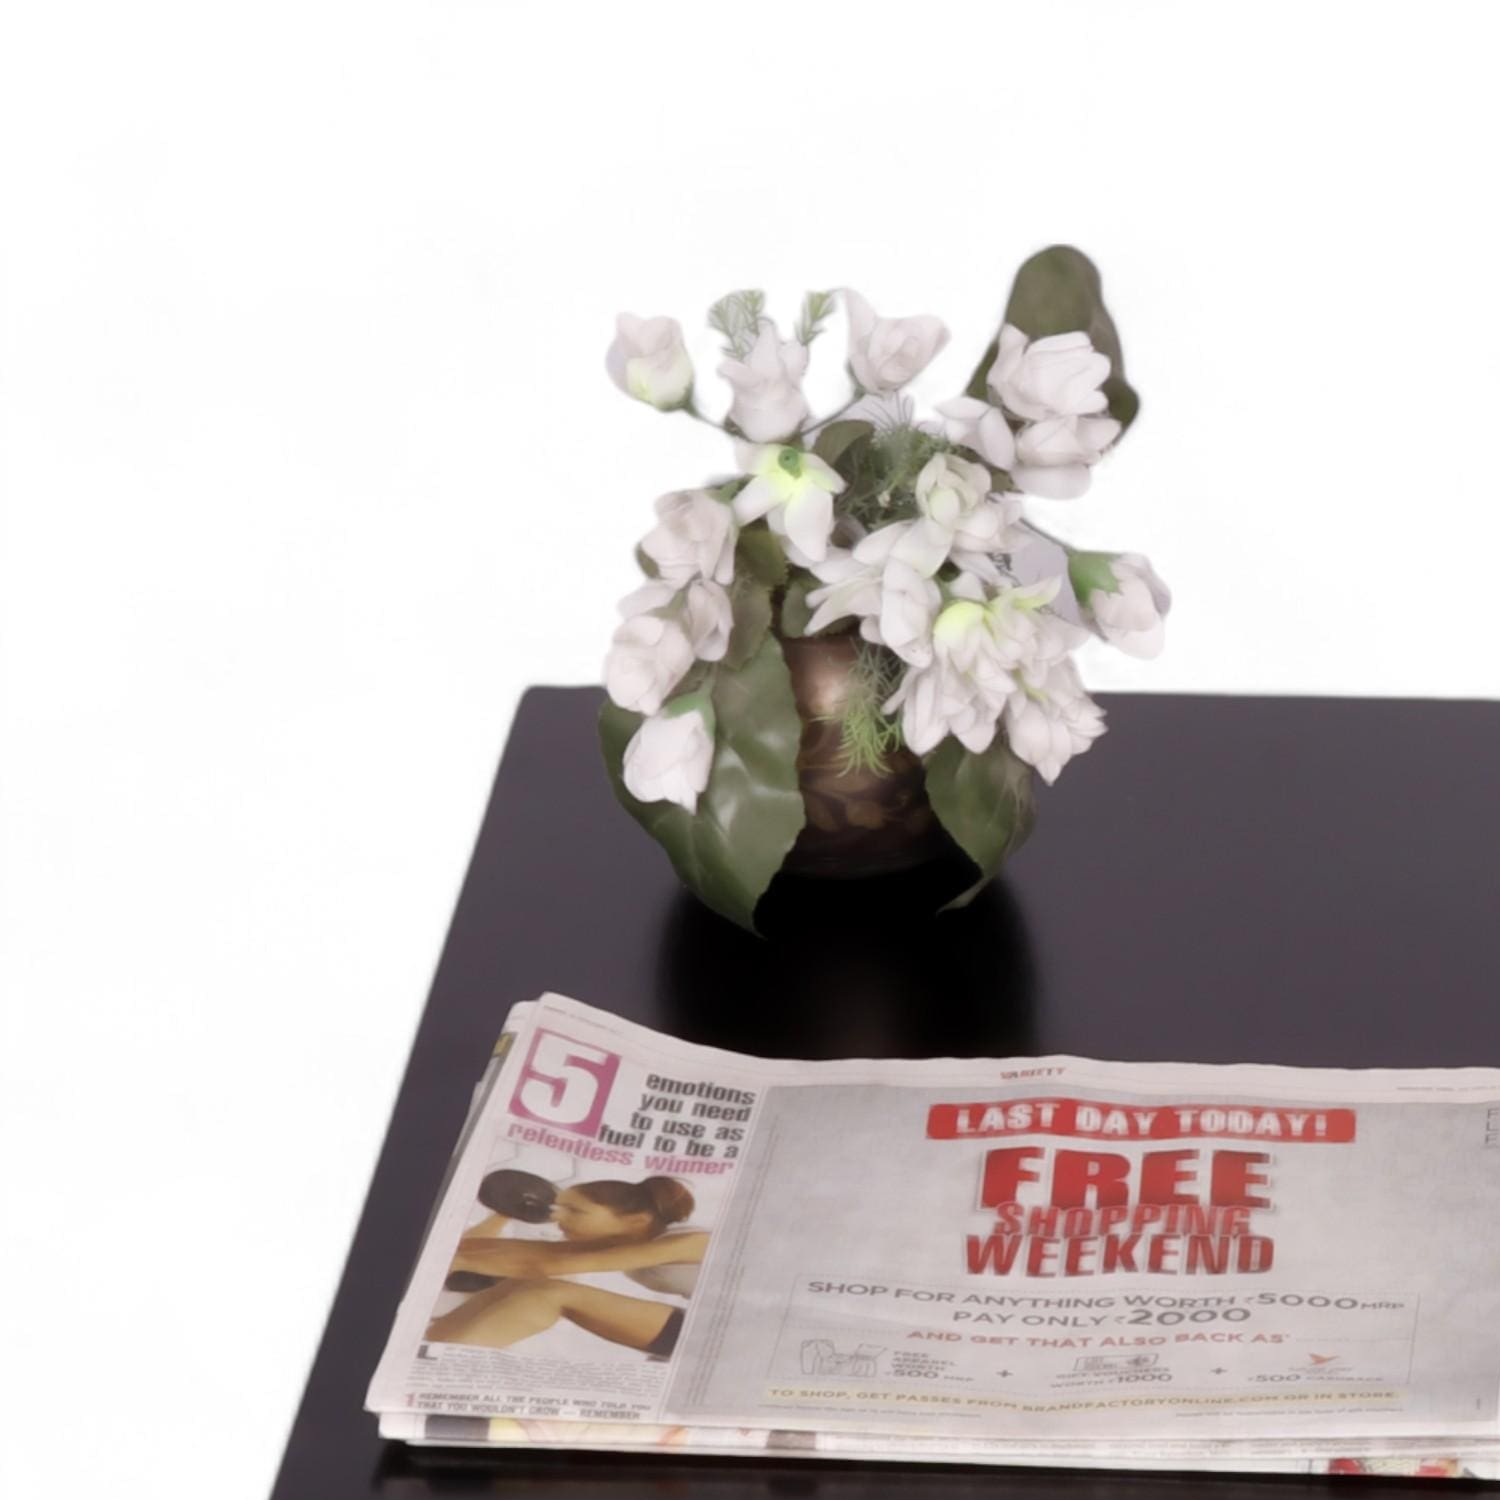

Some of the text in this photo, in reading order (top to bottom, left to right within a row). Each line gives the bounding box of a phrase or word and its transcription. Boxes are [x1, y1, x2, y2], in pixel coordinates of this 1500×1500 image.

[520, 1029, 609, 1126] 5
[646, 1073, 756, 1105] emotions
[639, 1094, 752, 1122] you need
[956, 1102, 1328, 1138] LAST DAY TODAY!
[598, 1124, 739, 1159] fuel to be a
[630, 1111, 744, 1142] to use as
[507, 1122, 735, 1175] relentless winner
[980, 1145, 1274, 1210] FREE
[993, 1201, 1254, 1238] SHOPPING
[965, 1233, 1275, 1278] WEEKEND
[808, 1281, 889, 1297] SHOP
[894, 1288, 956, 1303] FOR
[961, 1293, 1116, 1309] ANYTHING
[1123, 1294, 1237, 1309] WORTH
[953, 1310, 1015, 1325] PAY
[1021, 1314, 1109, 1328] ONLY
[906, 1330, 962, 1342] AND
[970, 1335, 1020, 1346] GET
[1026, 1337, 1093, 1348] THAT
[1099, 1335, 1167, 1347] ALSO
[1175, 1332, 1245, 1344] BACK
[770, 1388, 794, 1398] TO
[856, 1391, 890, 1401] GET
[896, 1394, 961, 1405] PASSES
[967, 1399, 1018, 1409] FROM
